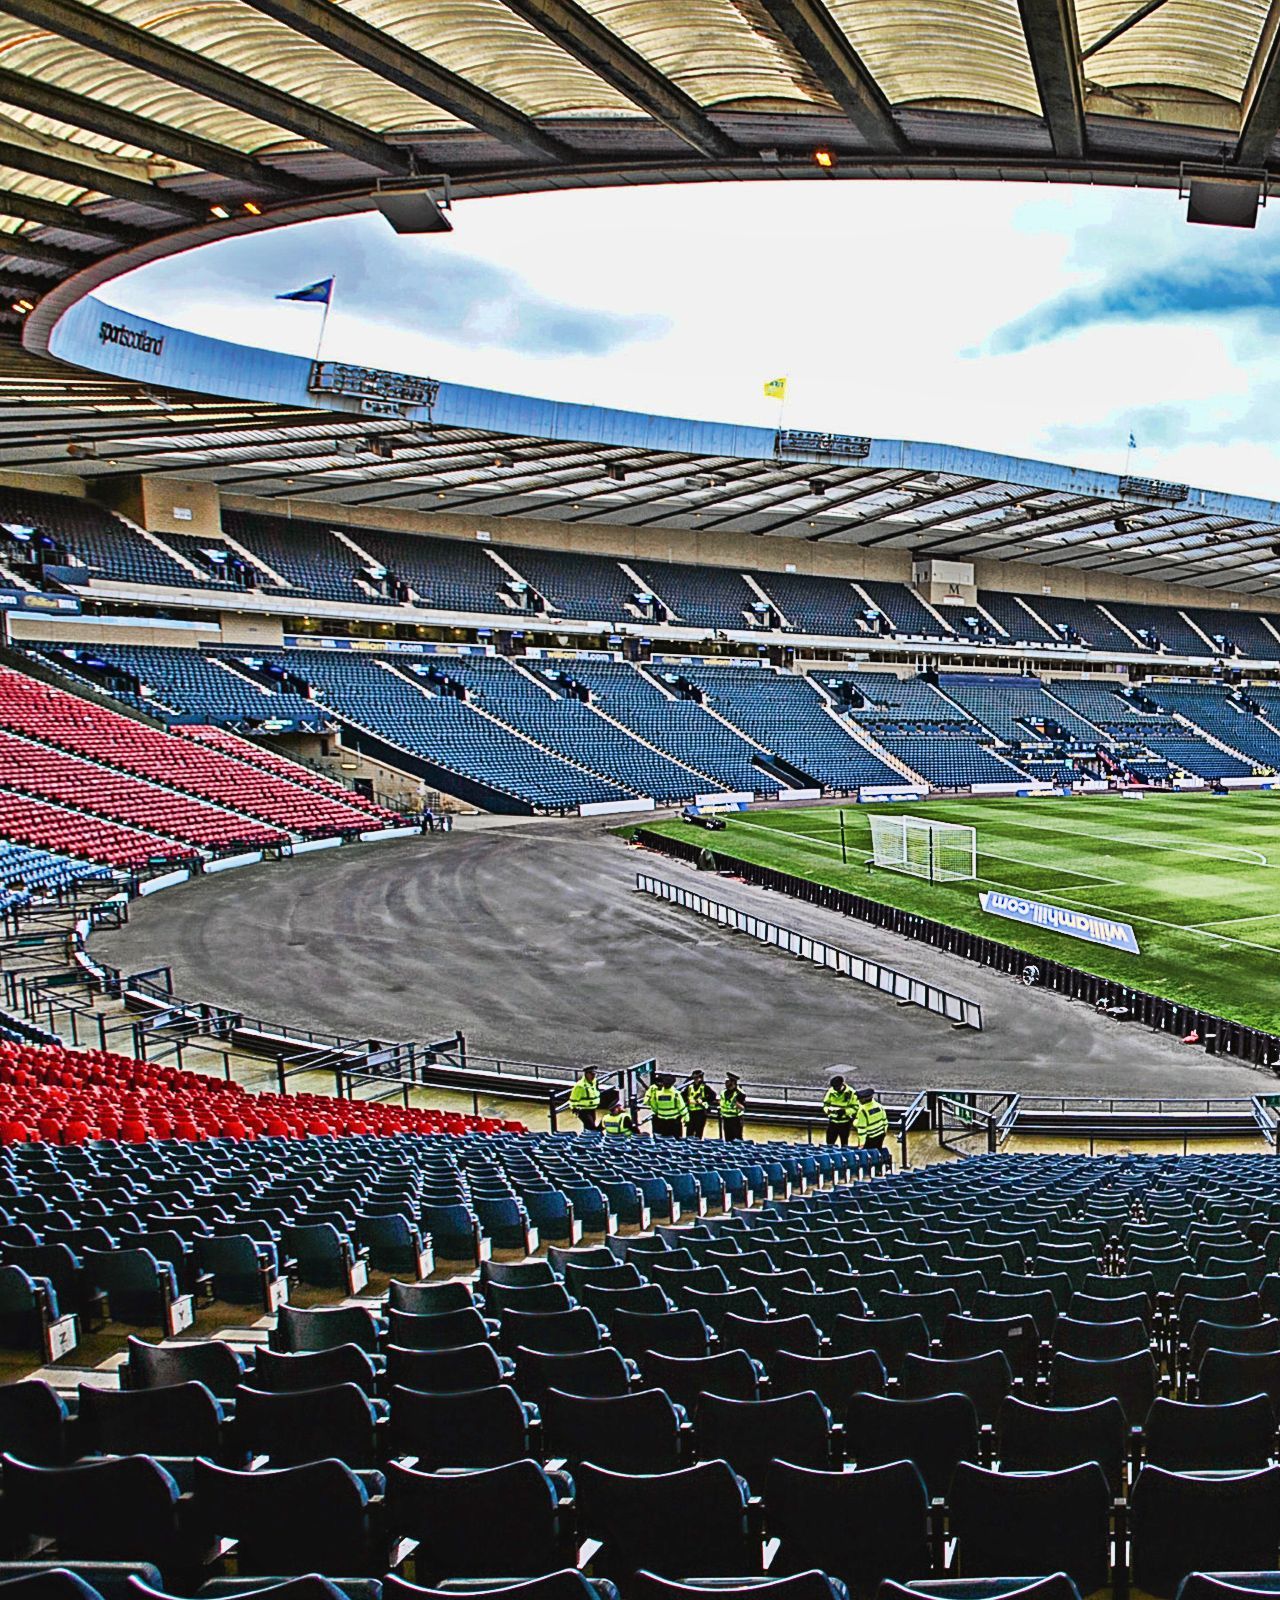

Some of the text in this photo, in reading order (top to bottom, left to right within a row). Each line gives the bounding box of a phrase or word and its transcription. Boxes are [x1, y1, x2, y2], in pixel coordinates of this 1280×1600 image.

[99, 321, 164, 355] sportscotland
[949, 583, 960, 595] M
[349, 641, 423, 653] williamhill.com
[992, 894, 1128, 942] williamhill.com
[58, 1331, 67, 1345] Z
